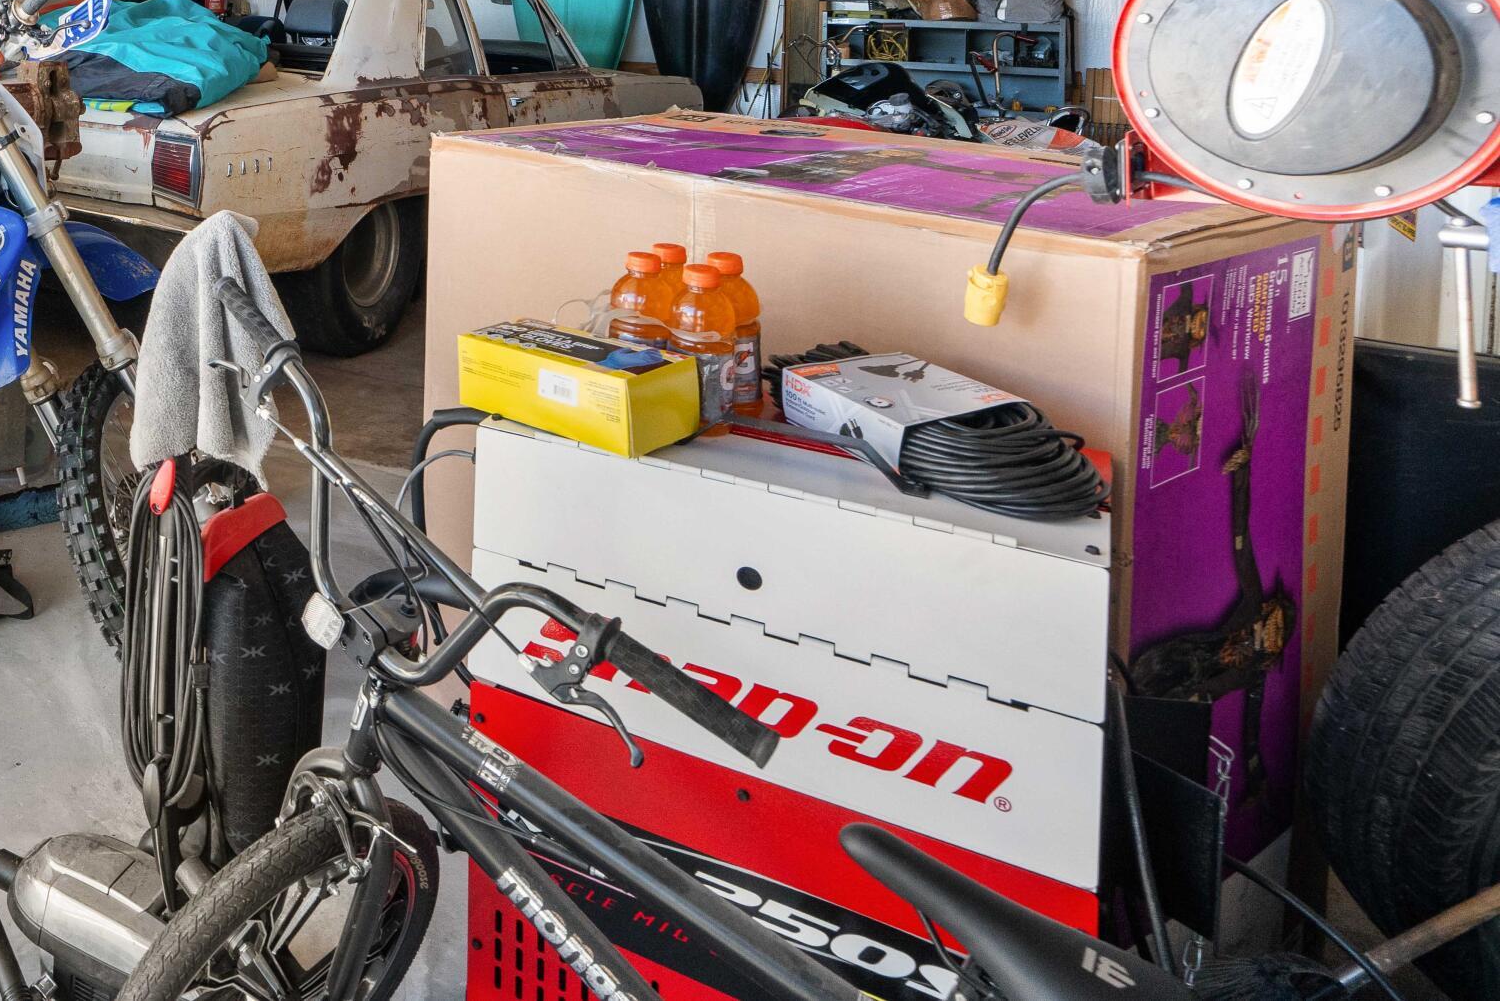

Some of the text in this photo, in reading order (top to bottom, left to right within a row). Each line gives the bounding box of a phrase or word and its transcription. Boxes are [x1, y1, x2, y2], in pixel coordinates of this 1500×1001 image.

[1276, 253, 1289, 286] 15
[13, 259, 37, 357] YAMAHA
[785, 374, 811, 398] HDX
